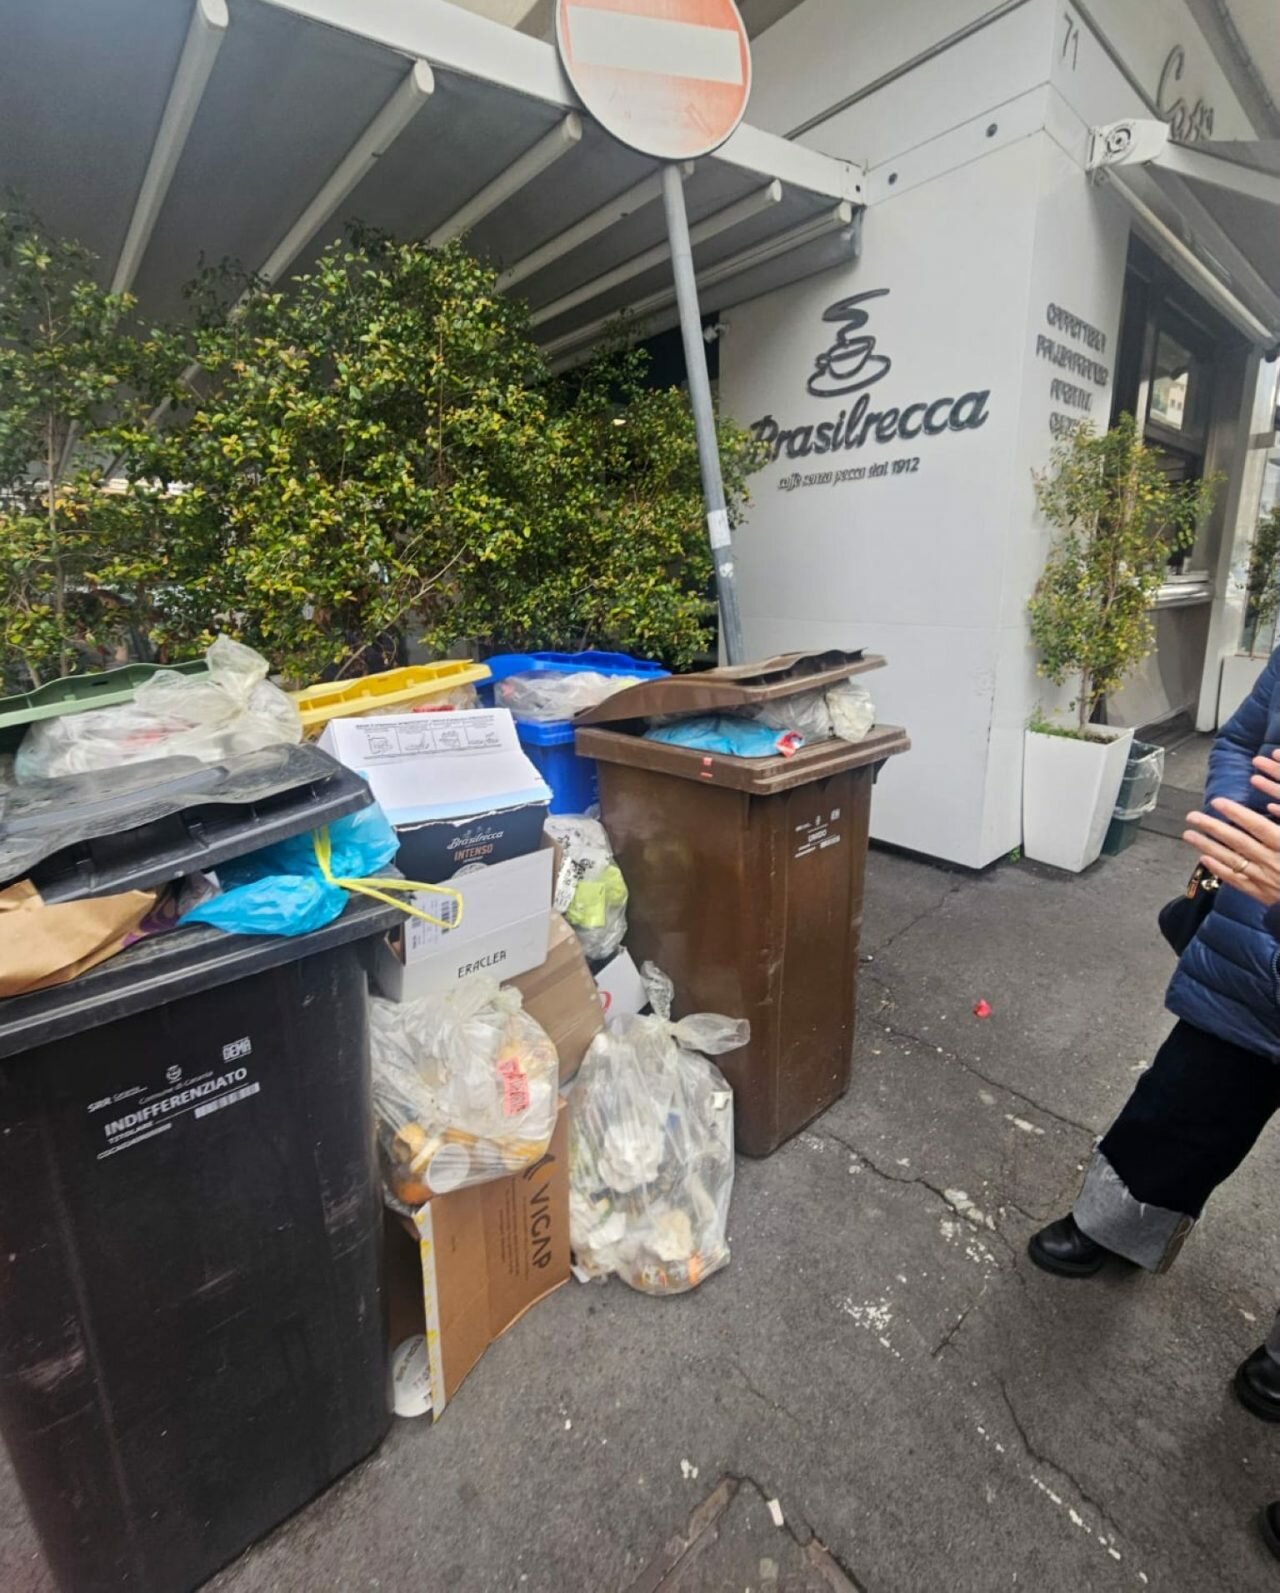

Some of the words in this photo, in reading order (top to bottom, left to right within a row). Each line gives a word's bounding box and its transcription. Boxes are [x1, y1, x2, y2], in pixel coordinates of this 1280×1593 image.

[750, 389, 991, 465] Brasilrecca
[891, 456, 921, 476] 1912
[454, 844, 494, 862] INTENSO
[458, 950, 507, 978] ERACLEA
[104, 1067, 247, 1137] INDIFFERENZIATO
